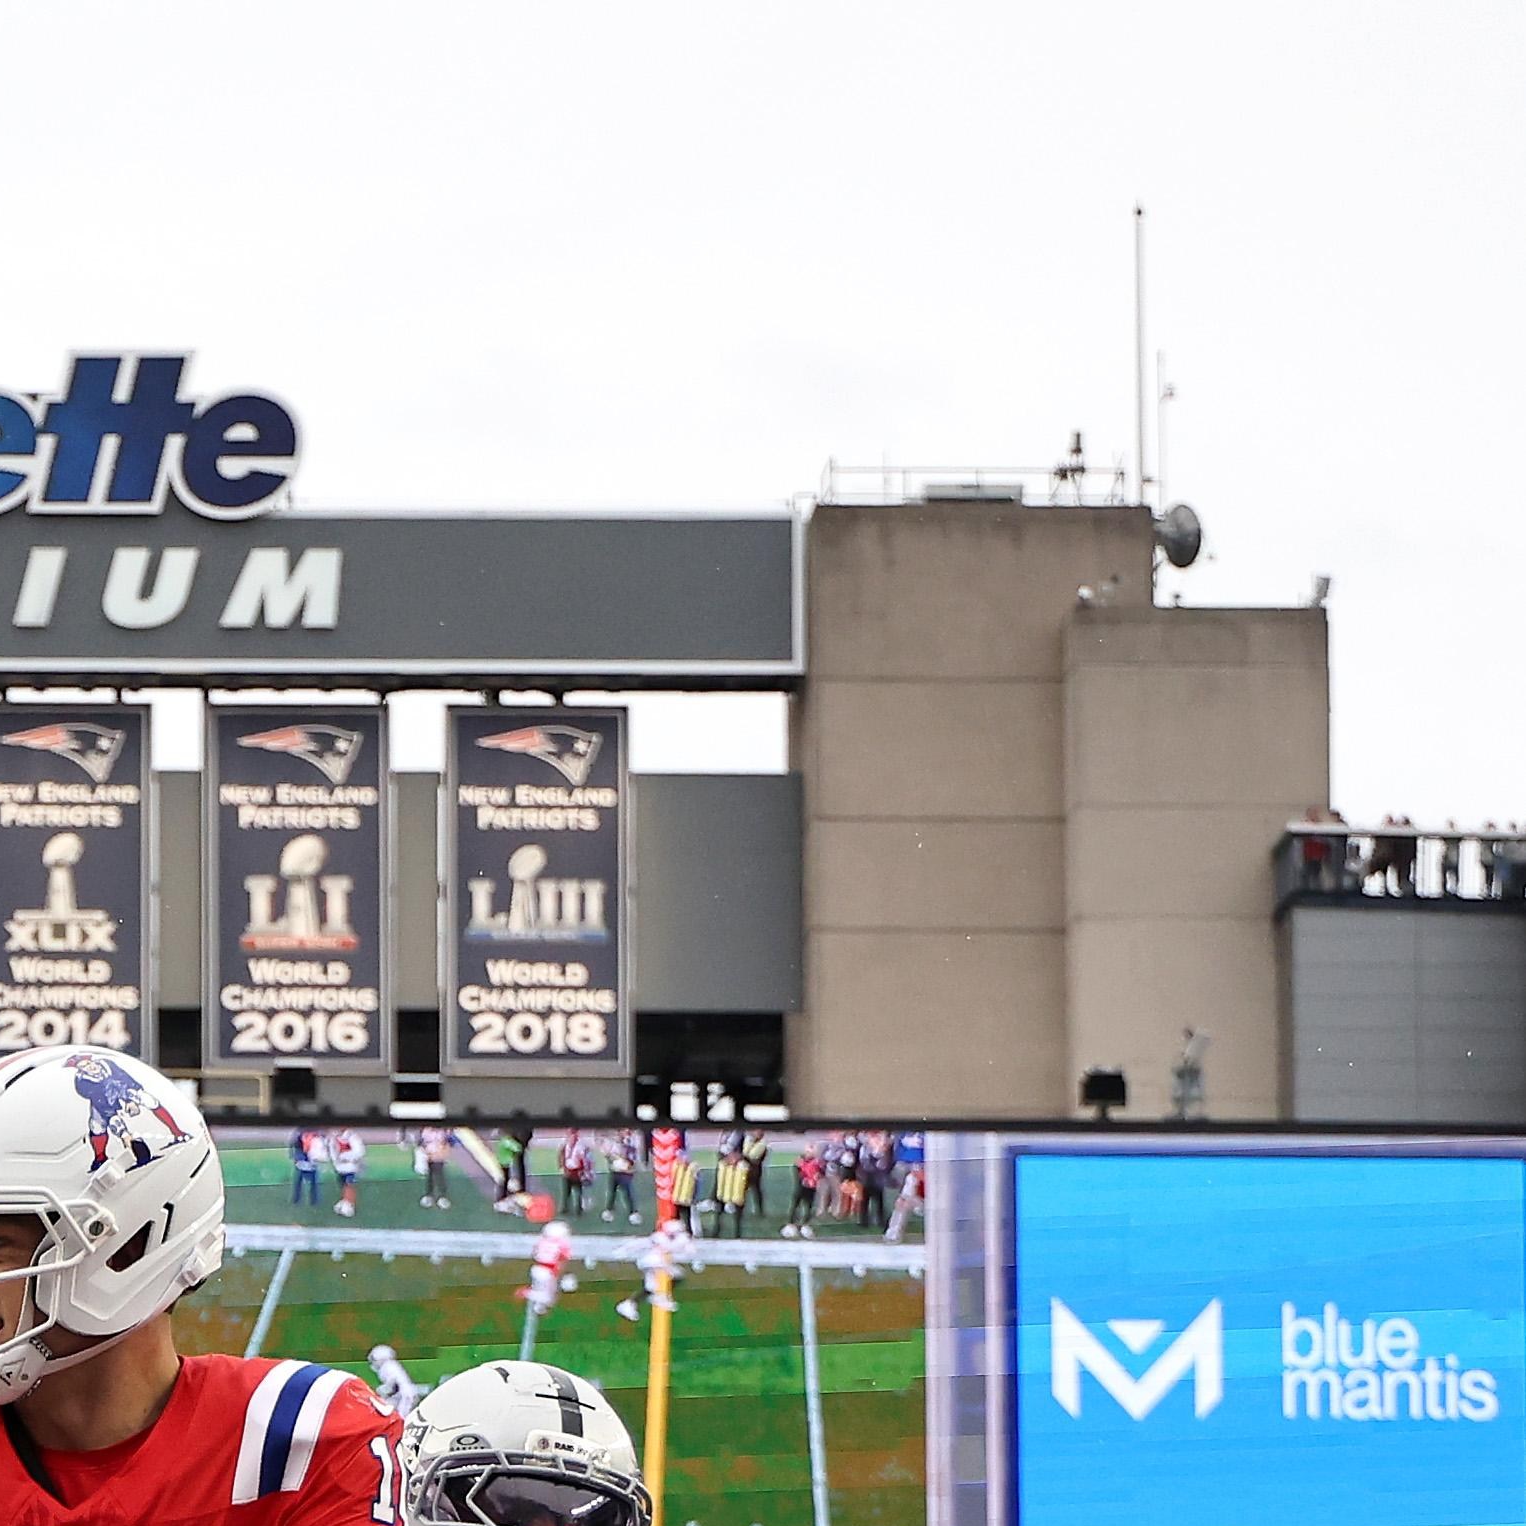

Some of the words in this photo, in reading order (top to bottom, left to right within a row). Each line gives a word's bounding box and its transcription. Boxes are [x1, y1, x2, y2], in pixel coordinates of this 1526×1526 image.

[0, 804, 121, 829] PATRIOTS
[237, 806, 360, 831] PATRIOTS
[476, 807, 599, 832] PATRIOTS
[4, 919, 117, 953] XLIX
[9, 955, 112, 984] WORLD
[248, 958, 351, 985] WORLD
[485, 958, 589, 986] WORLD
[220, 984, 378, 1012] CHAMPIONS
[458, 985, 617, 1013] CHAMPIONS
[230, 1011, 370, 1054] 2016
[469, 1011, 608, 1054] 2018
[1281, 1302, 1418, 1369] blue
[1281, 1357, 1499, 1421] mantis
